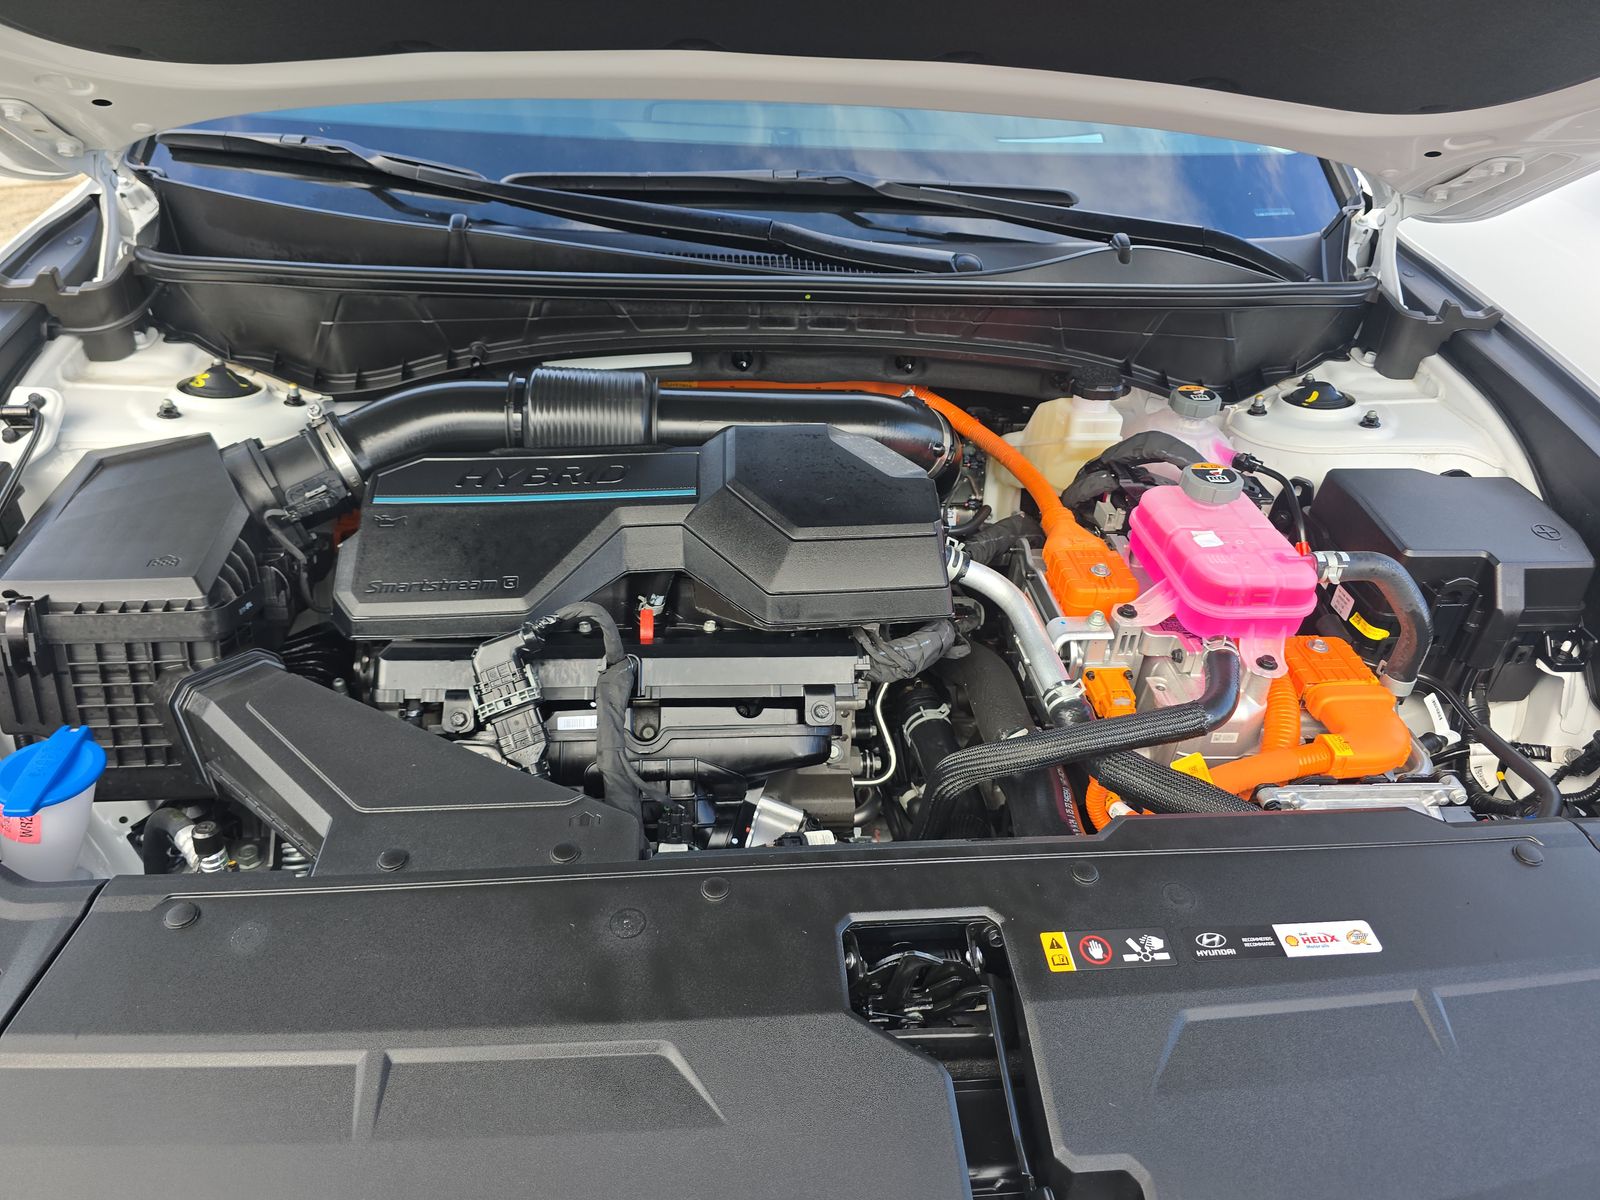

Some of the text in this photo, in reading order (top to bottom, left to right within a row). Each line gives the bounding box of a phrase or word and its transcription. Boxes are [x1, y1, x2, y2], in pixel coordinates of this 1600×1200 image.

[454, 464, 628, 489] HYBRID
[364, 578, 499, 594] Smartstream
[1301, 934, 1341, 945] HELIX
[1196, 948, 1237, 957] HYUNDAI
